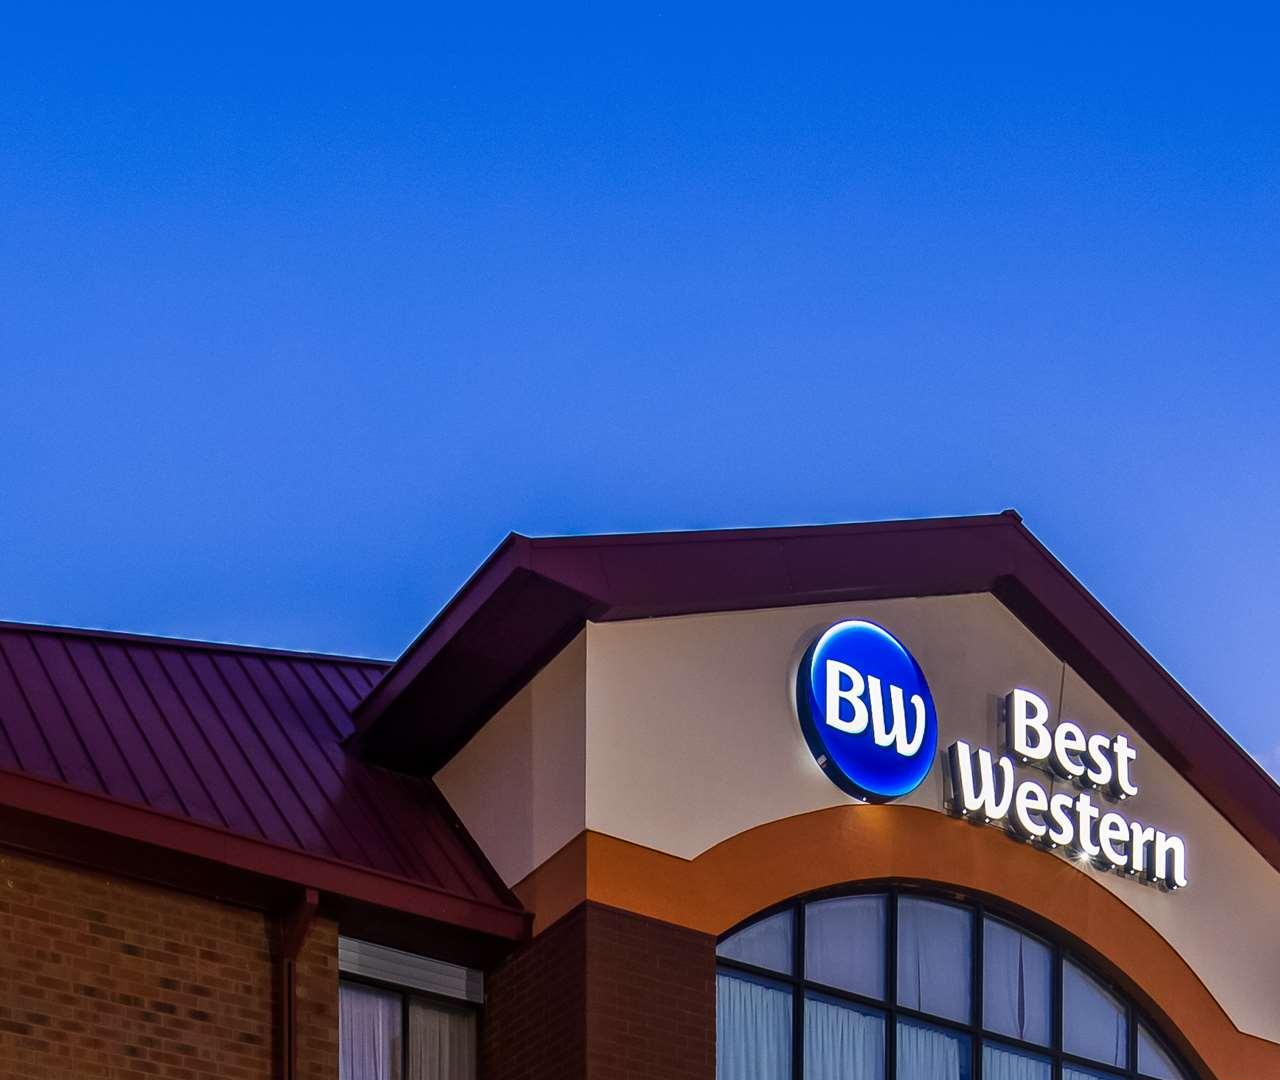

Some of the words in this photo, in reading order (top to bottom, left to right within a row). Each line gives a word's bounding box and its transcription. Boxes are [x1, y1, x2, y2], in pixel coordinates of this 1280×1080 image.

[826, 659, 926, 757] BW
[1013, 688, 1138, 797] Best
[955, 740, 1188, 888] Western
